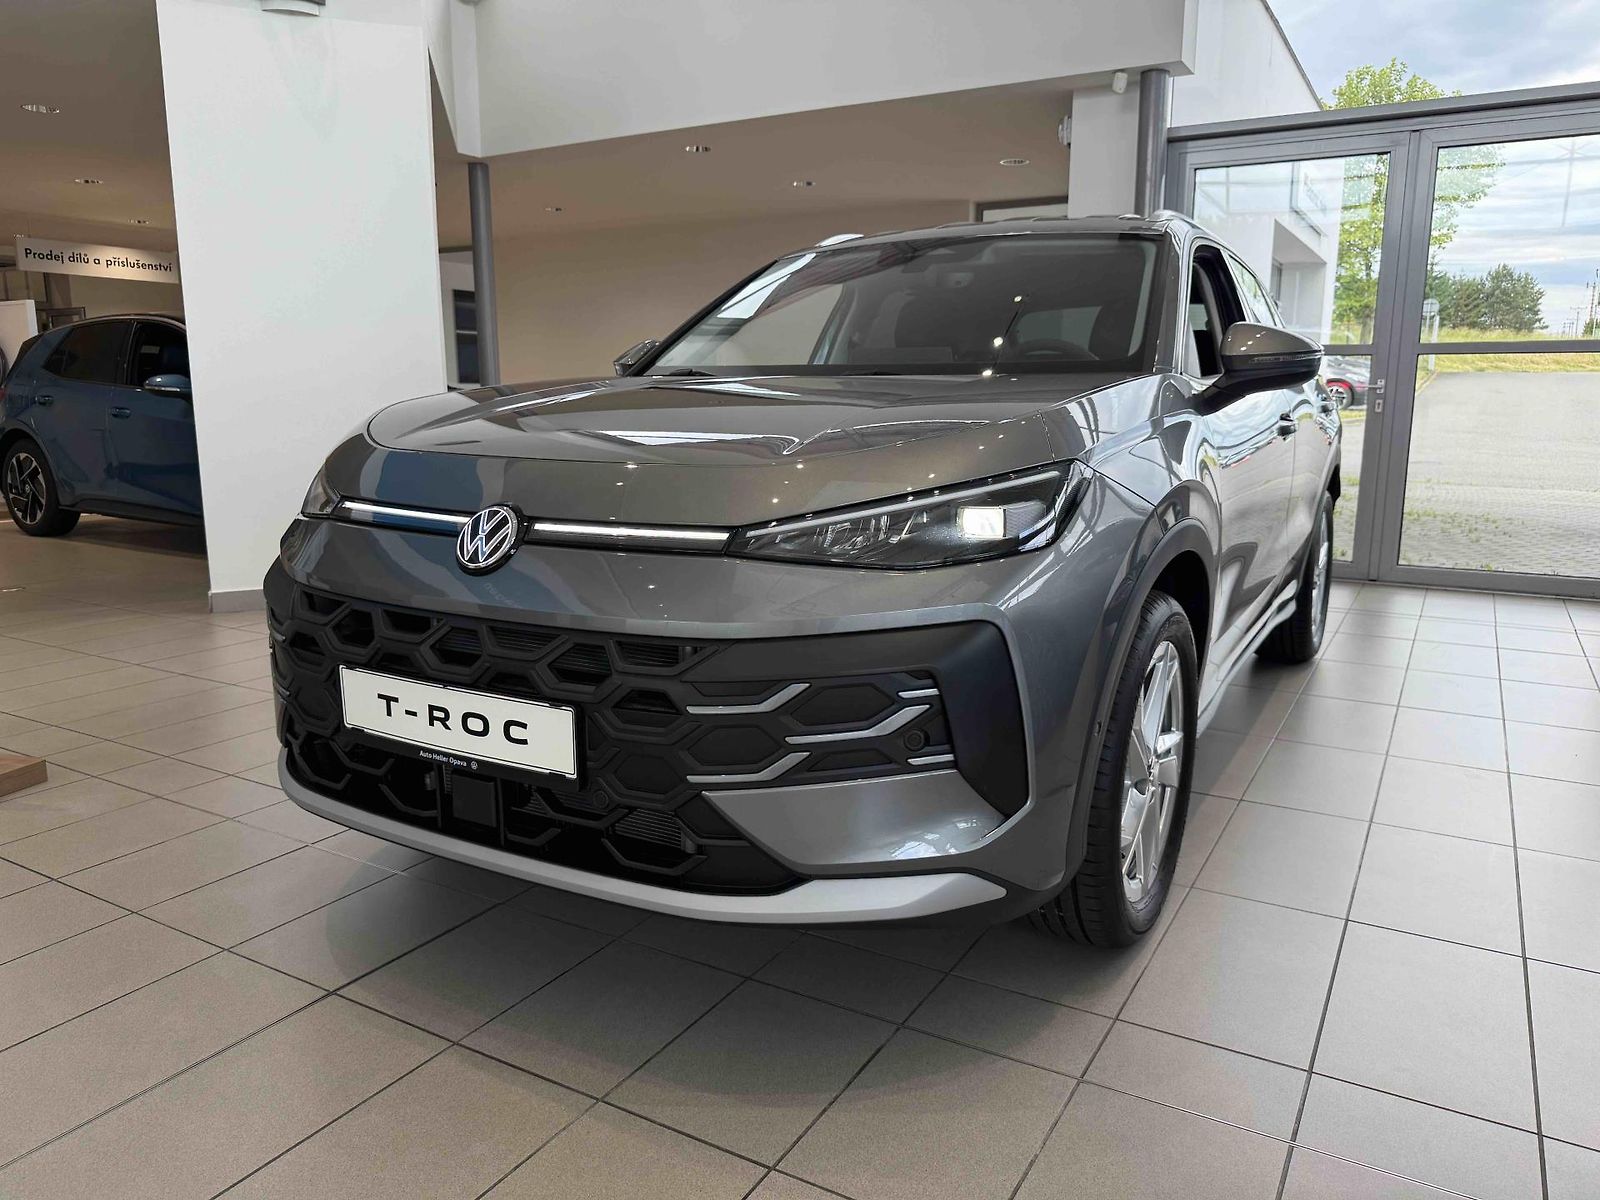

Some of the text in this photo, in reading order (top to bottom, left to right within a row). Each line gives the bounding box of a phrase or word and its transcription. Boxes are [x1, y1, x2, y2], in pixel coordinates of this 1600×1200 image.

[24, 247, 65, 265] Prodej
[68, 252, 90, 265] dílů
[106, 257, 172, 272] příslušenství
[377, 692, 529, 746] T-ROC
[419, 750, 432, 759] Auto
[433, 753, 448, 762] Heller
[449, 757, 467, 766] Opava
